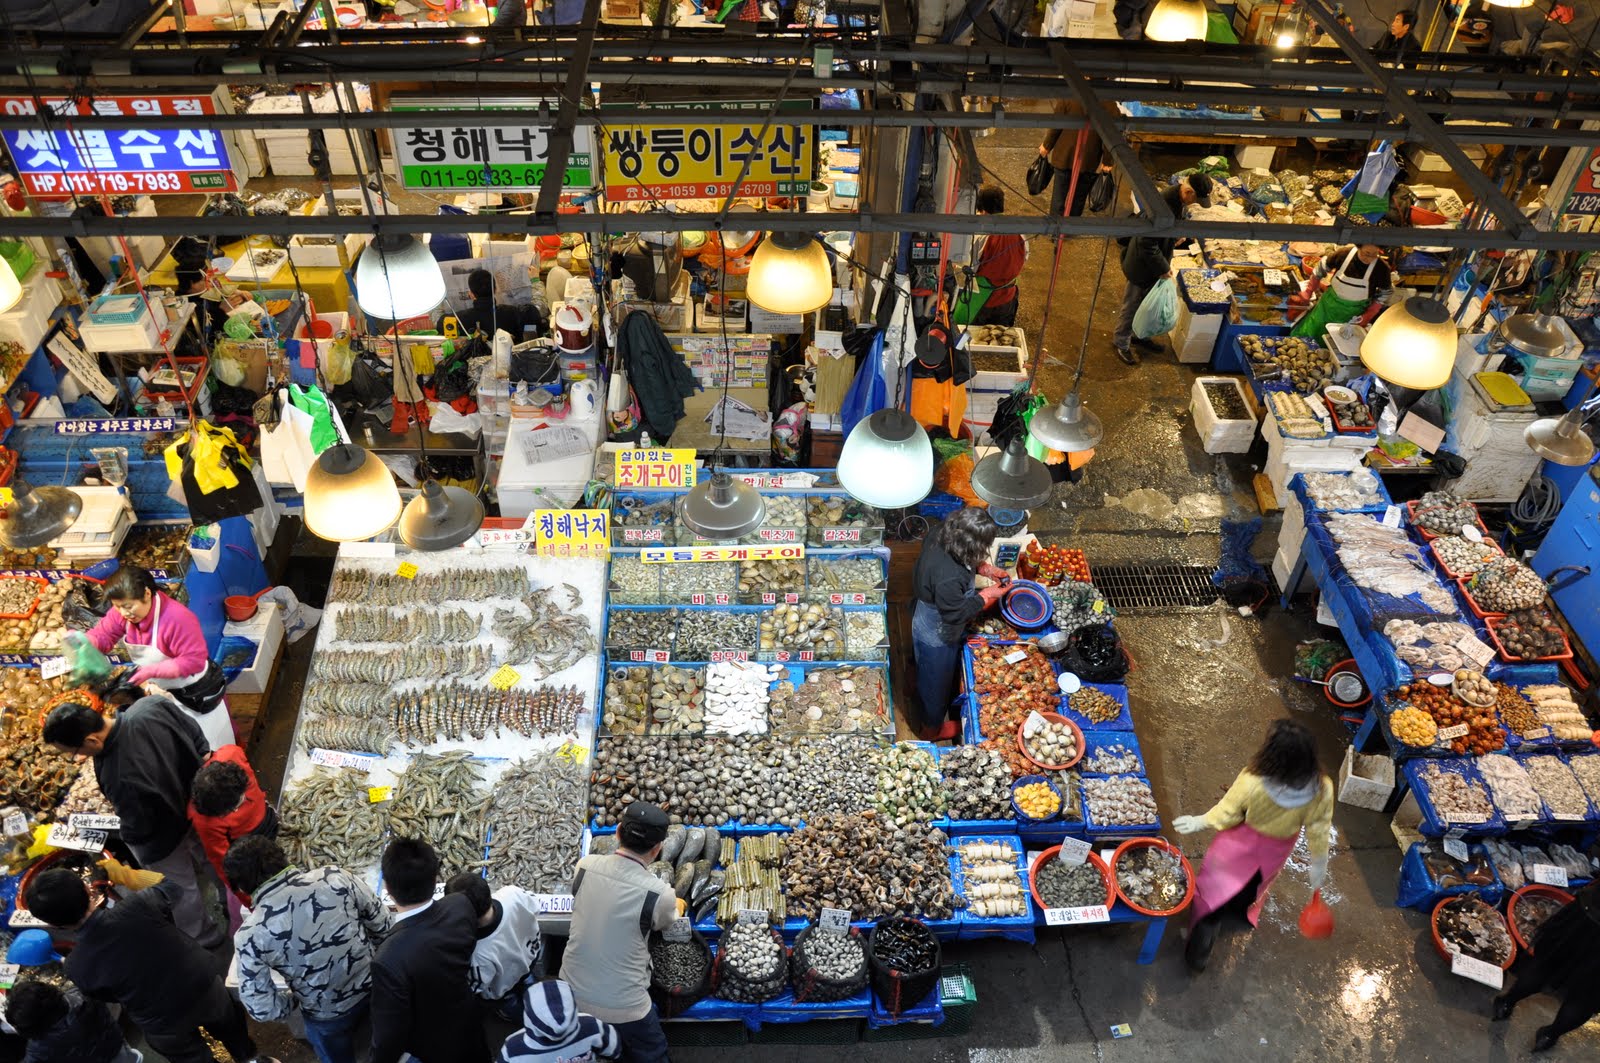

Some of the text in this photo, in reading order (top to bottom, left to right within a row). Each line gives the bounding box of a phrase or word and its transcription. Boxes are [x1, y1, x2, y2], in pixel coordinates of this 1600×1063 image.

[609, 127, 805, 178] 쌍둥이수산
[621, 451, 673, 462] 살아있는
[620, 464, 682, 487] 조개구이
[540, 513, 606, 539] 청해낙지
[761, 530, 795, 540] 떡조개
[825, 530, 859, 540] 칼조개
